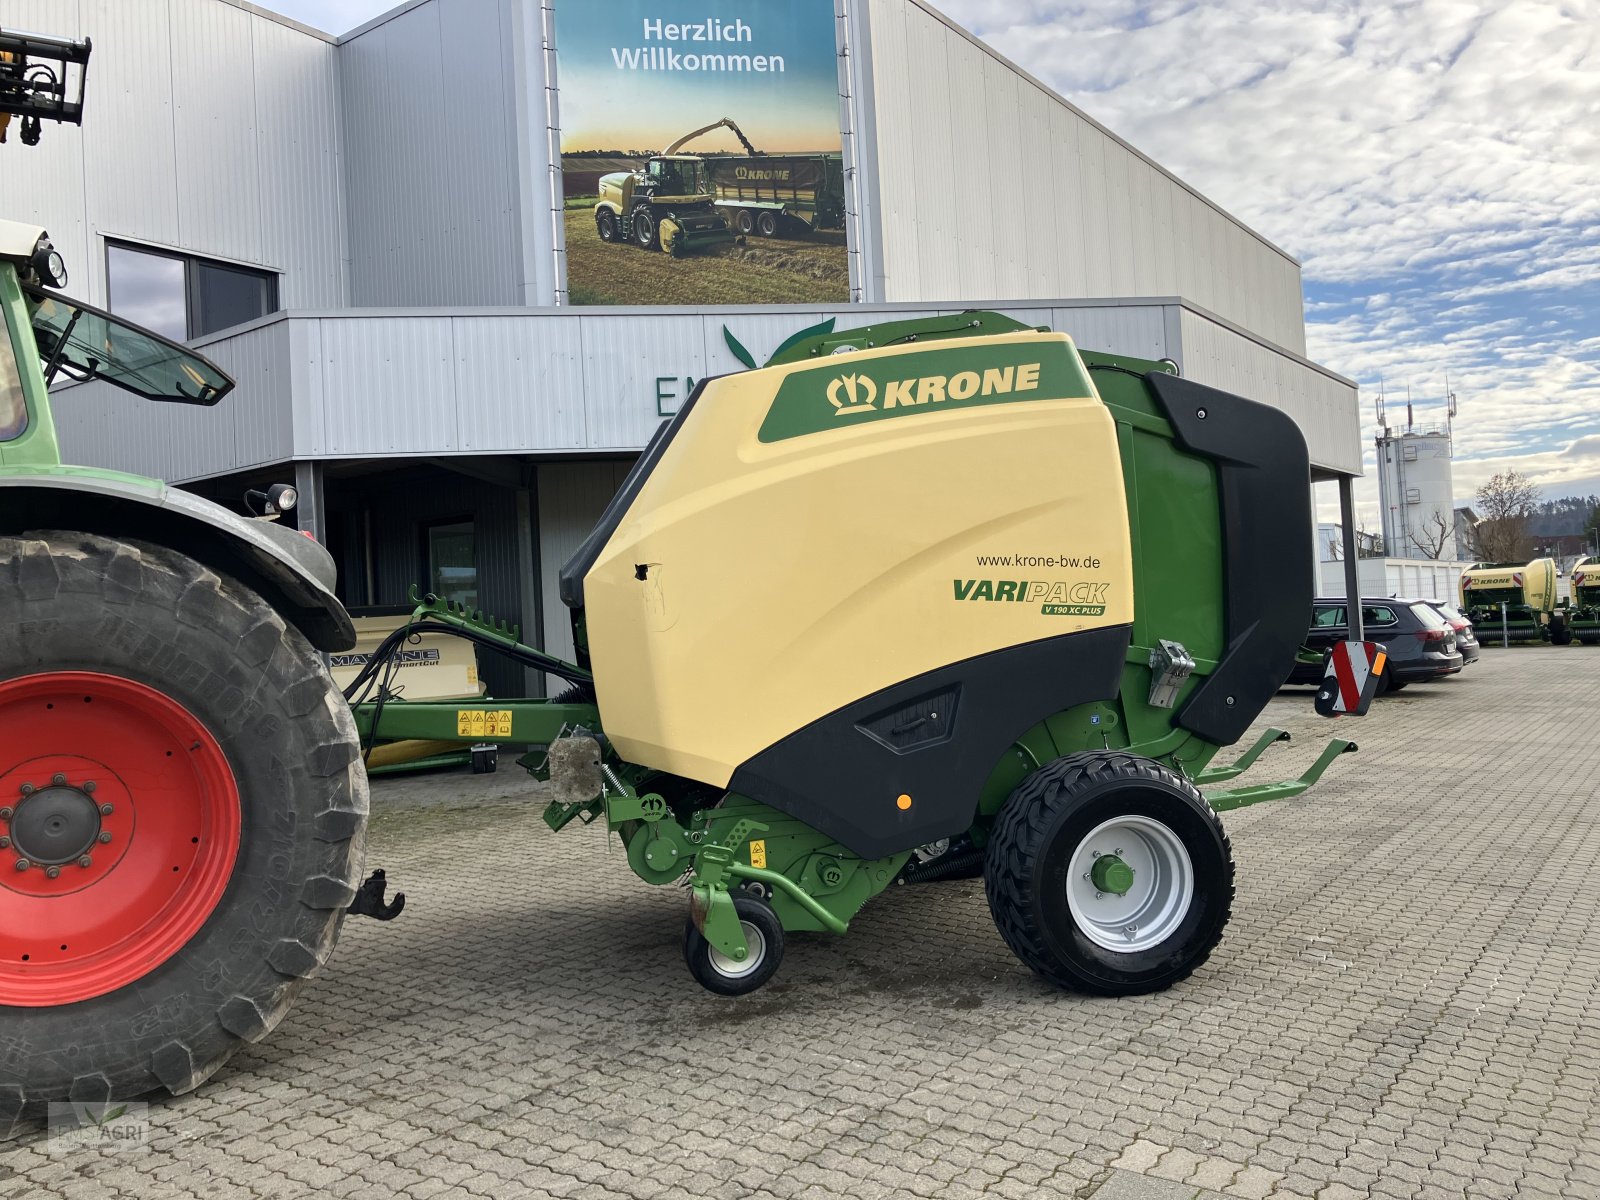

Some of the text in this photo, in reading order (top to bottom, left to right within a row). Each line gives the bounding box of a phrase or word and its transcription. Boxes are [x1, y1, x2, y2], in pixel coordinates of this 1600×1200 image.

[643, 18, 752, 42] Herzlich
[611, 47, 785, 72] Willkommen
[747, 169, 789, 181] KRONE
[883, 362, 1041, 409] KRONE
[976, 554, 1101, 569] www.krone-bw.de
[953, 579, 1110, 604] VARIPACK
